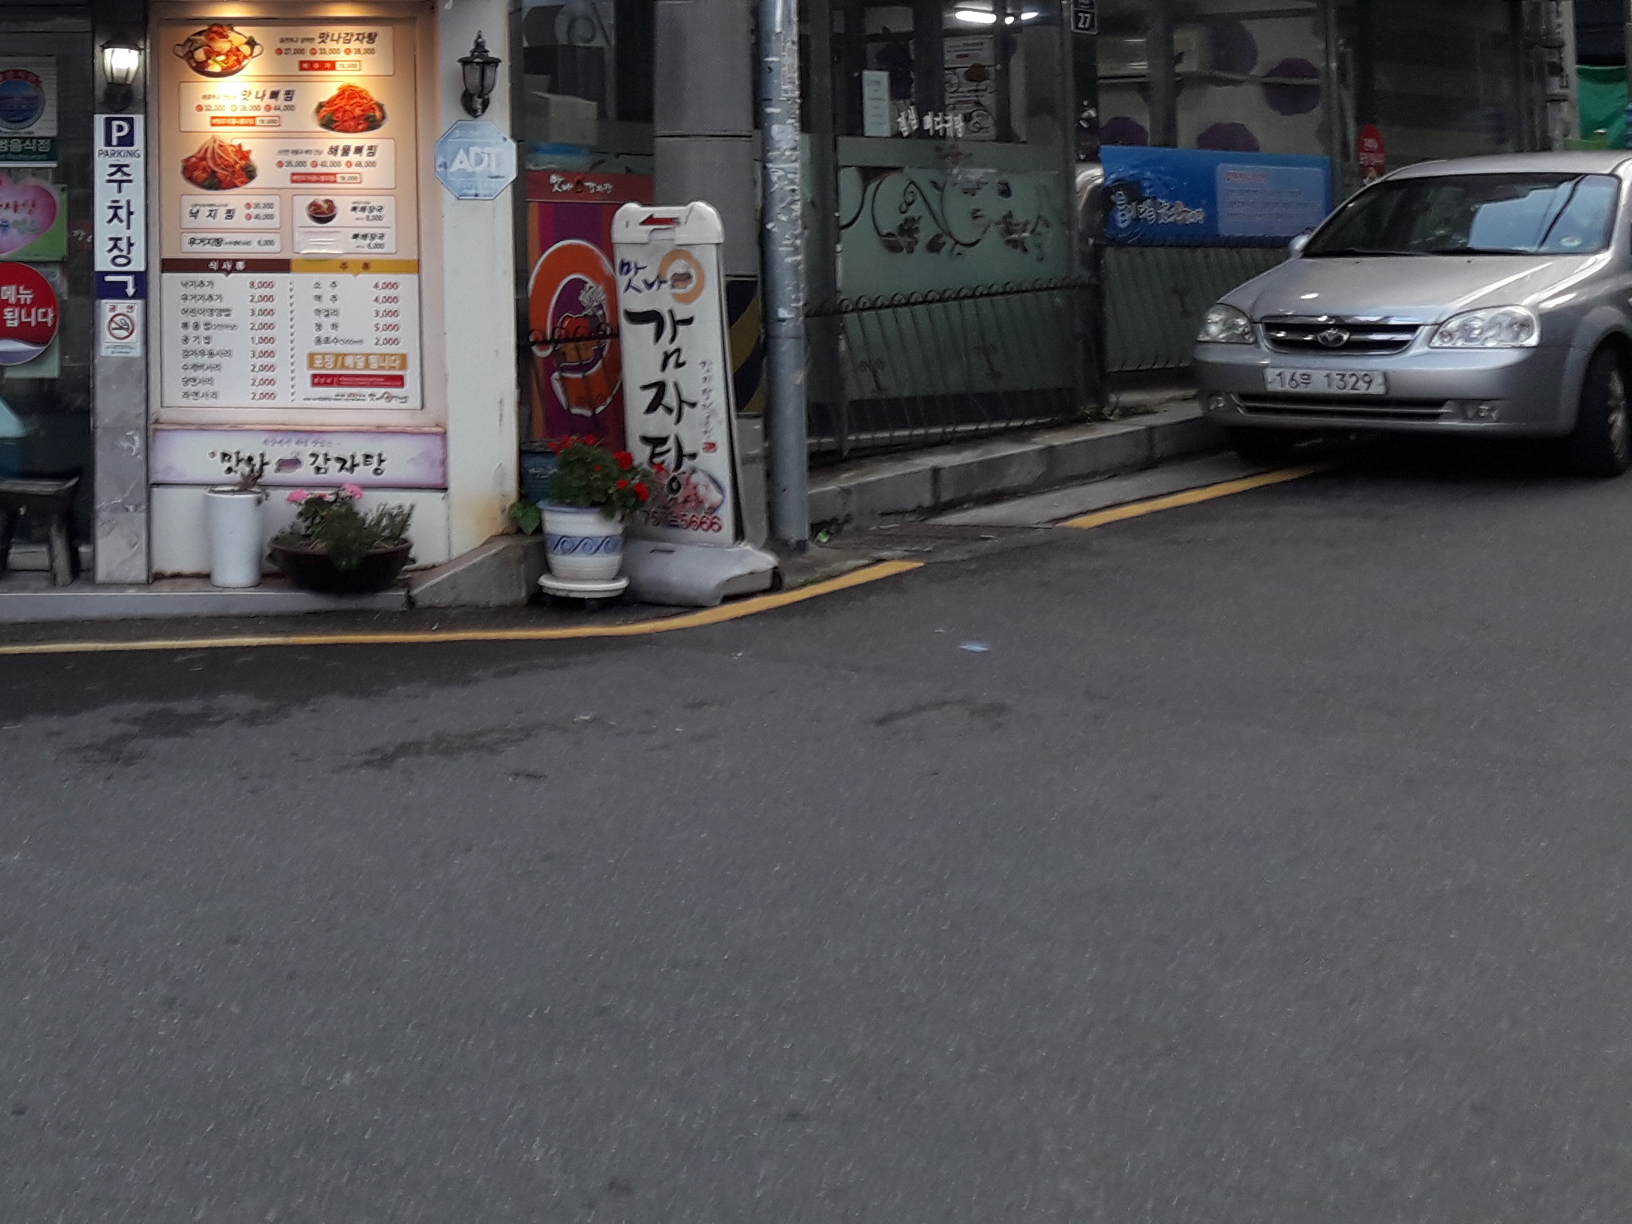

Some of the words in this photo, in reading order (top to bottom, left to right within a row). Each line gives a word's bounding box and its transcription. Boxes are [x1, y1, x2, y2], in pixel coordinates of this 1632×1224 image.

[1078, 12, 1091, 28] 27
[317, 30, 379, 45] 맛나감자탕
[111, 120, 129, 145] P
[97, 148, 141, 159] PARKING
[449, 146, 502, 174] ADT
[106, 163, 135, 268] 주차장
[619, 258, 668, 295] 맛나
[372, 281, 400, 291] 4,000
[248, 294, 275, 303] 2,000
[373, 295, 400, 304] 4,000
[3, 306, 55, 328] 됩니다
[249, 308, 276, 317] 3,000
[373, 309, 400, 319] 3,000
[249, 322, 276, 331] 2,000
[373, 323, 400, 333] 5,000
[249, 336, 276, 345] 1,000
[373, 337, 401, 347] 2,000
[250, 350, 276, 359] 3,000
[250, 364, 276, 373] 2,000
[250, 378, 277, 387] 2,000
[1323, 372, 1374, 392] 1329
[250, 391, 278, 401] 2,000
[622, 308, 699, 497] 감자탕
[308, 451, 389, 477] 감자탕
